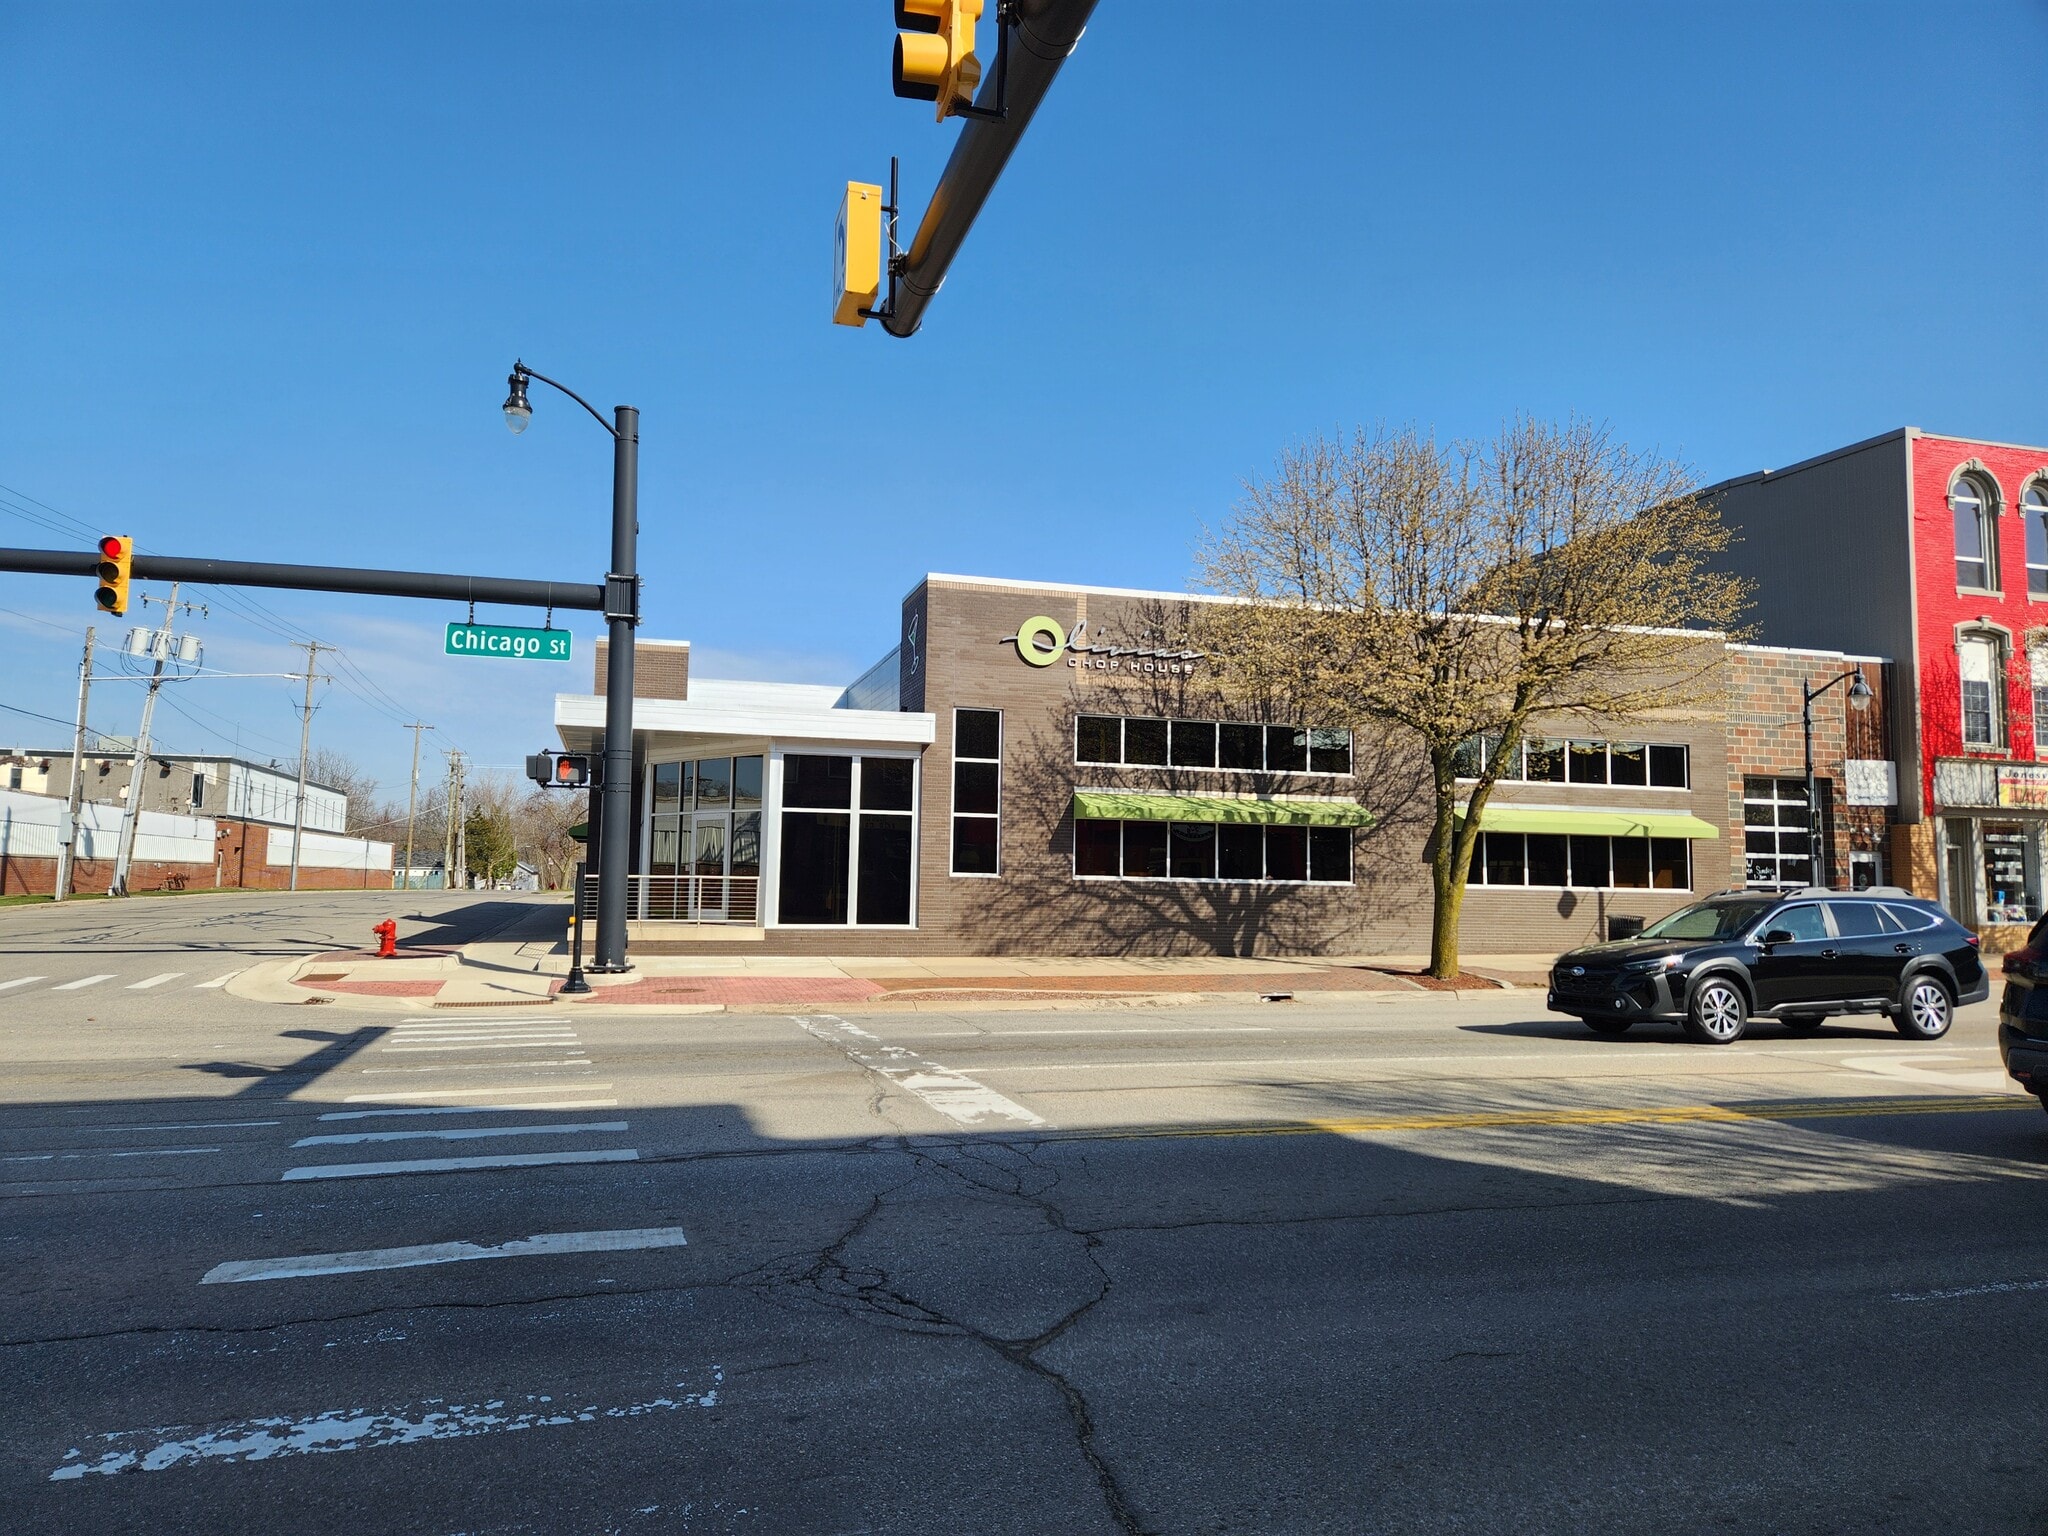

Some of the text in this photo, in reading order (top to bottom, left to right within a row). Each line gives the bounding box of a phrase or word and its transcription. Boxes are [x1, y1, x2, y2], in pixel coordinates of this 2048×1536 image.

[451, 630, 566, 657] Chicago St
[1068, 658, 1193, 675] CHOP HOUSE
